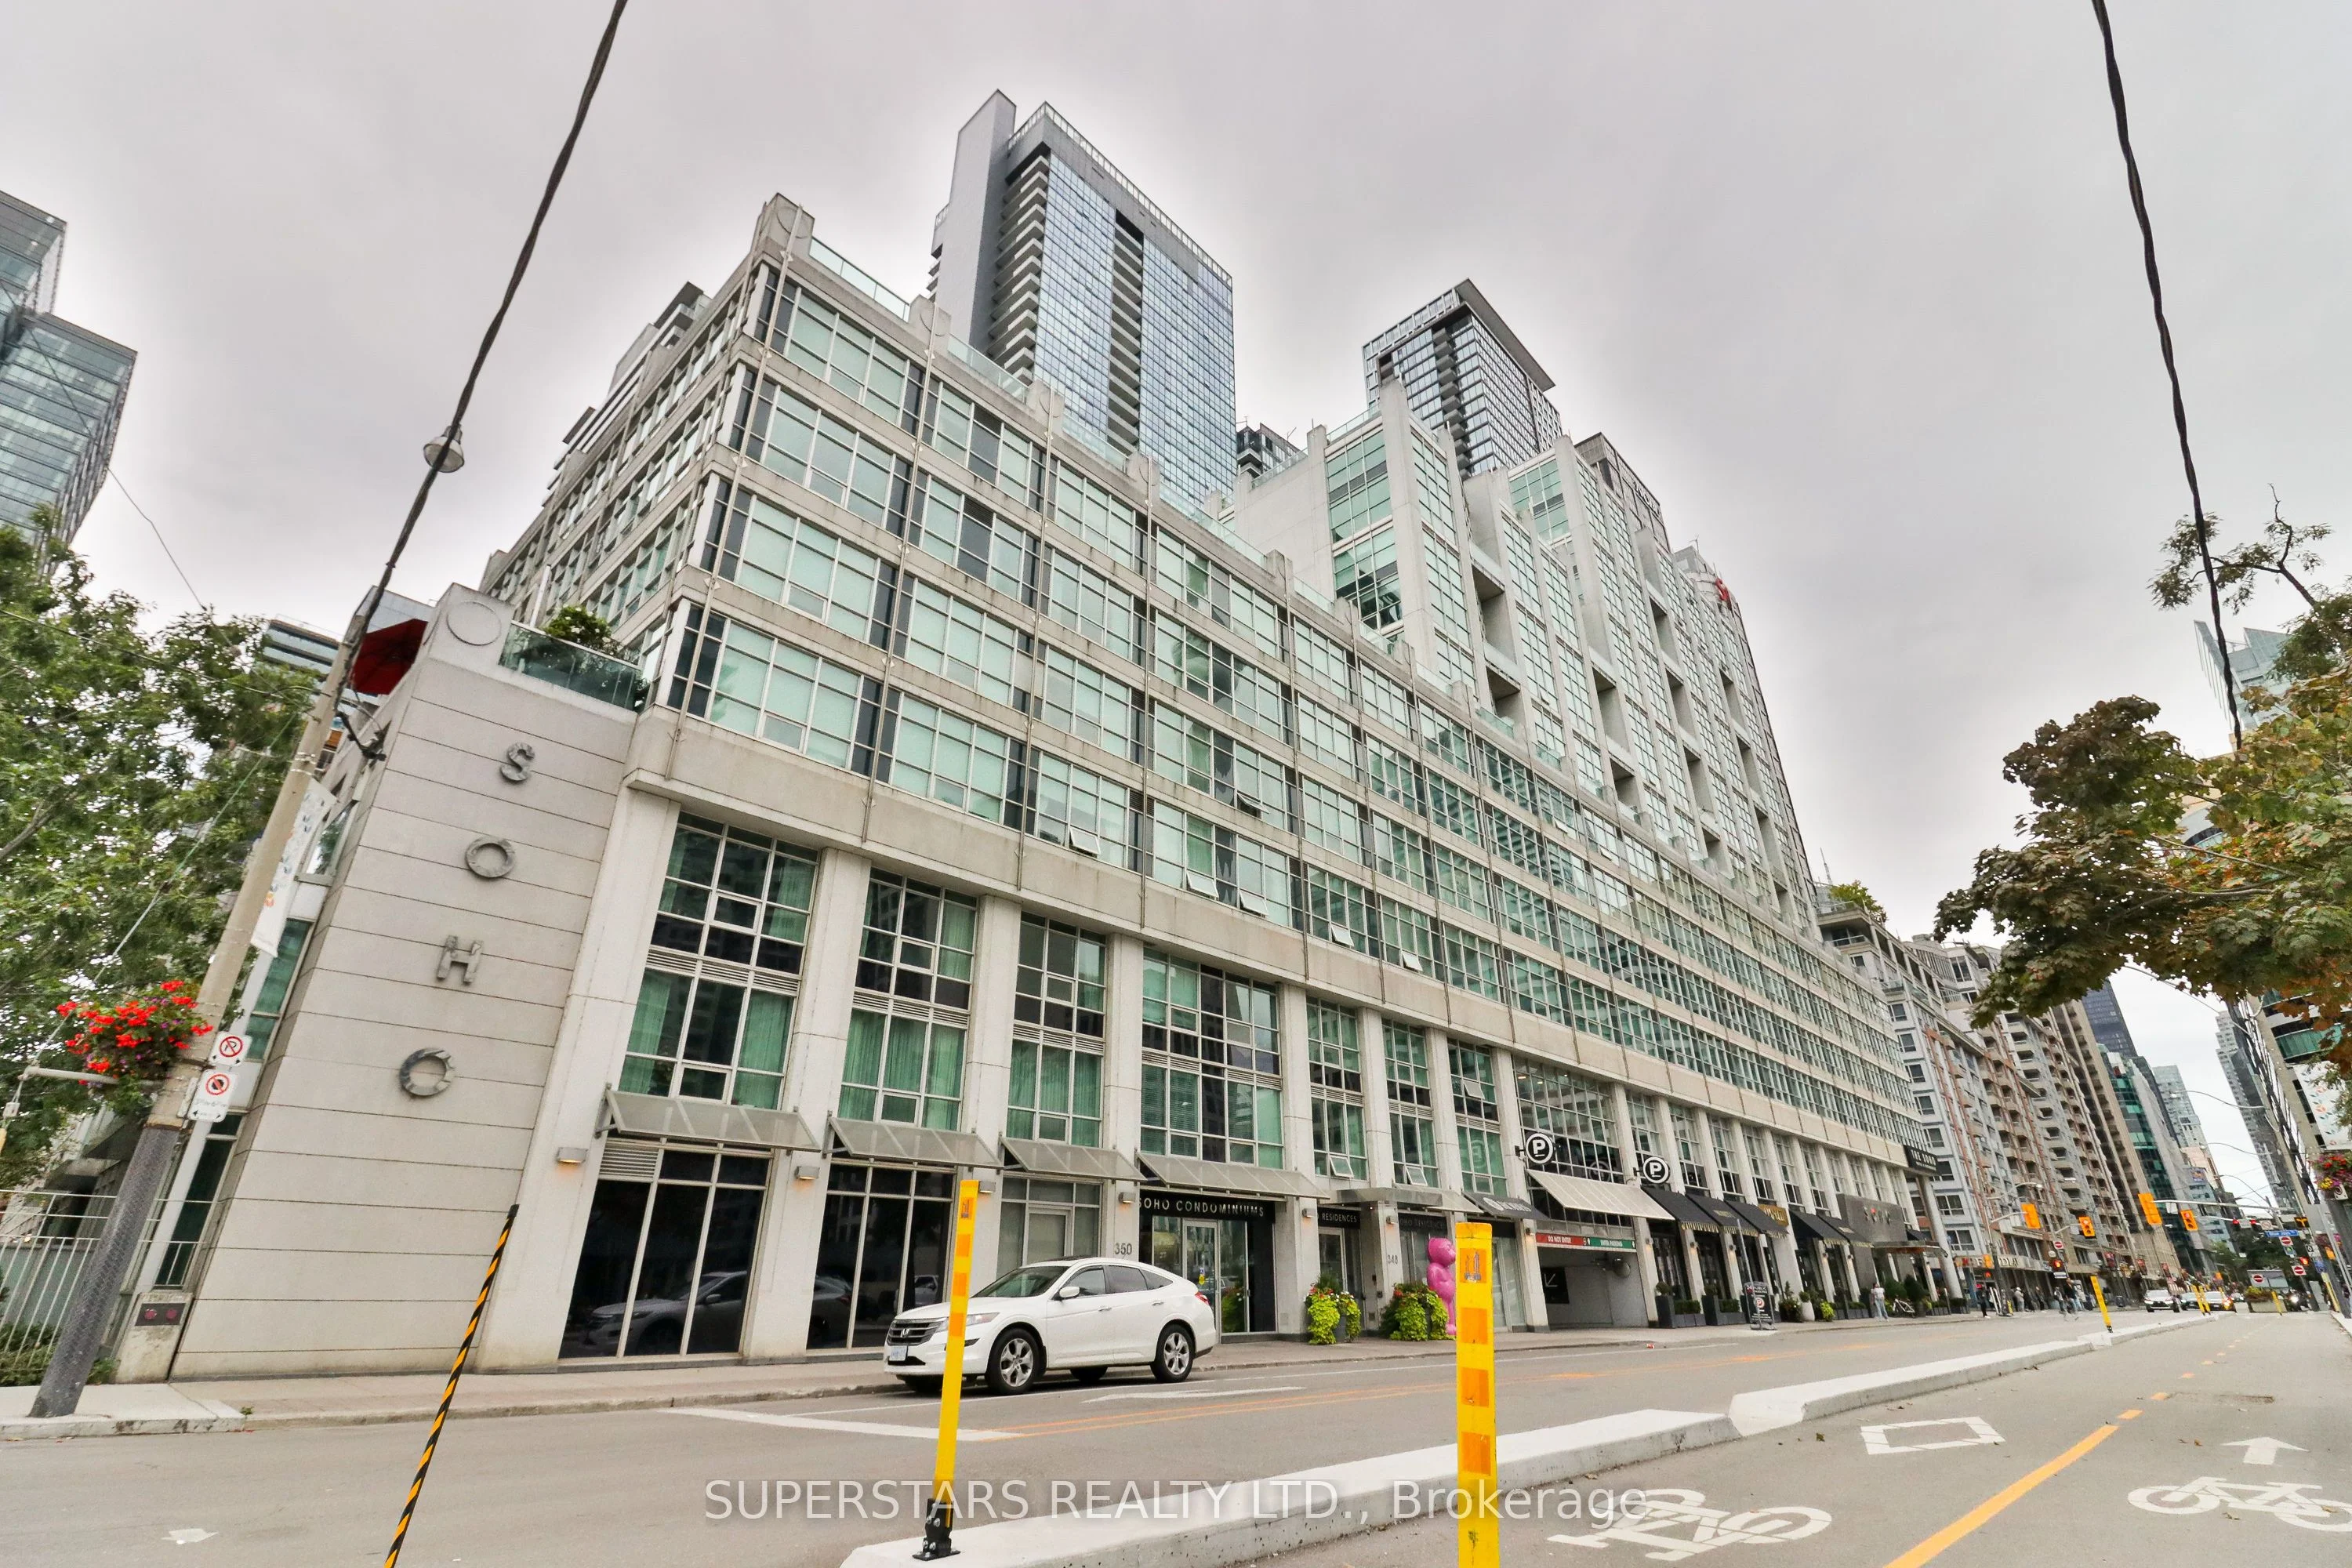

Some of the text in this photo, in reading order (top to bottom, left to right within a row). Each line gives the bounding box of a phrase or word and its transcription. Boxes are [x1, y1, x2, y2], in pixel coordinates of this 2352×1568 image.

[1176, 1200, 1264, 1217] CONDOMINIUMS
[1322, 1212, 1357, 1223] RESIDENCES
[1114, 1243, 1132, 1255] 350
[1387, 1254, 1399, 1265] 348
